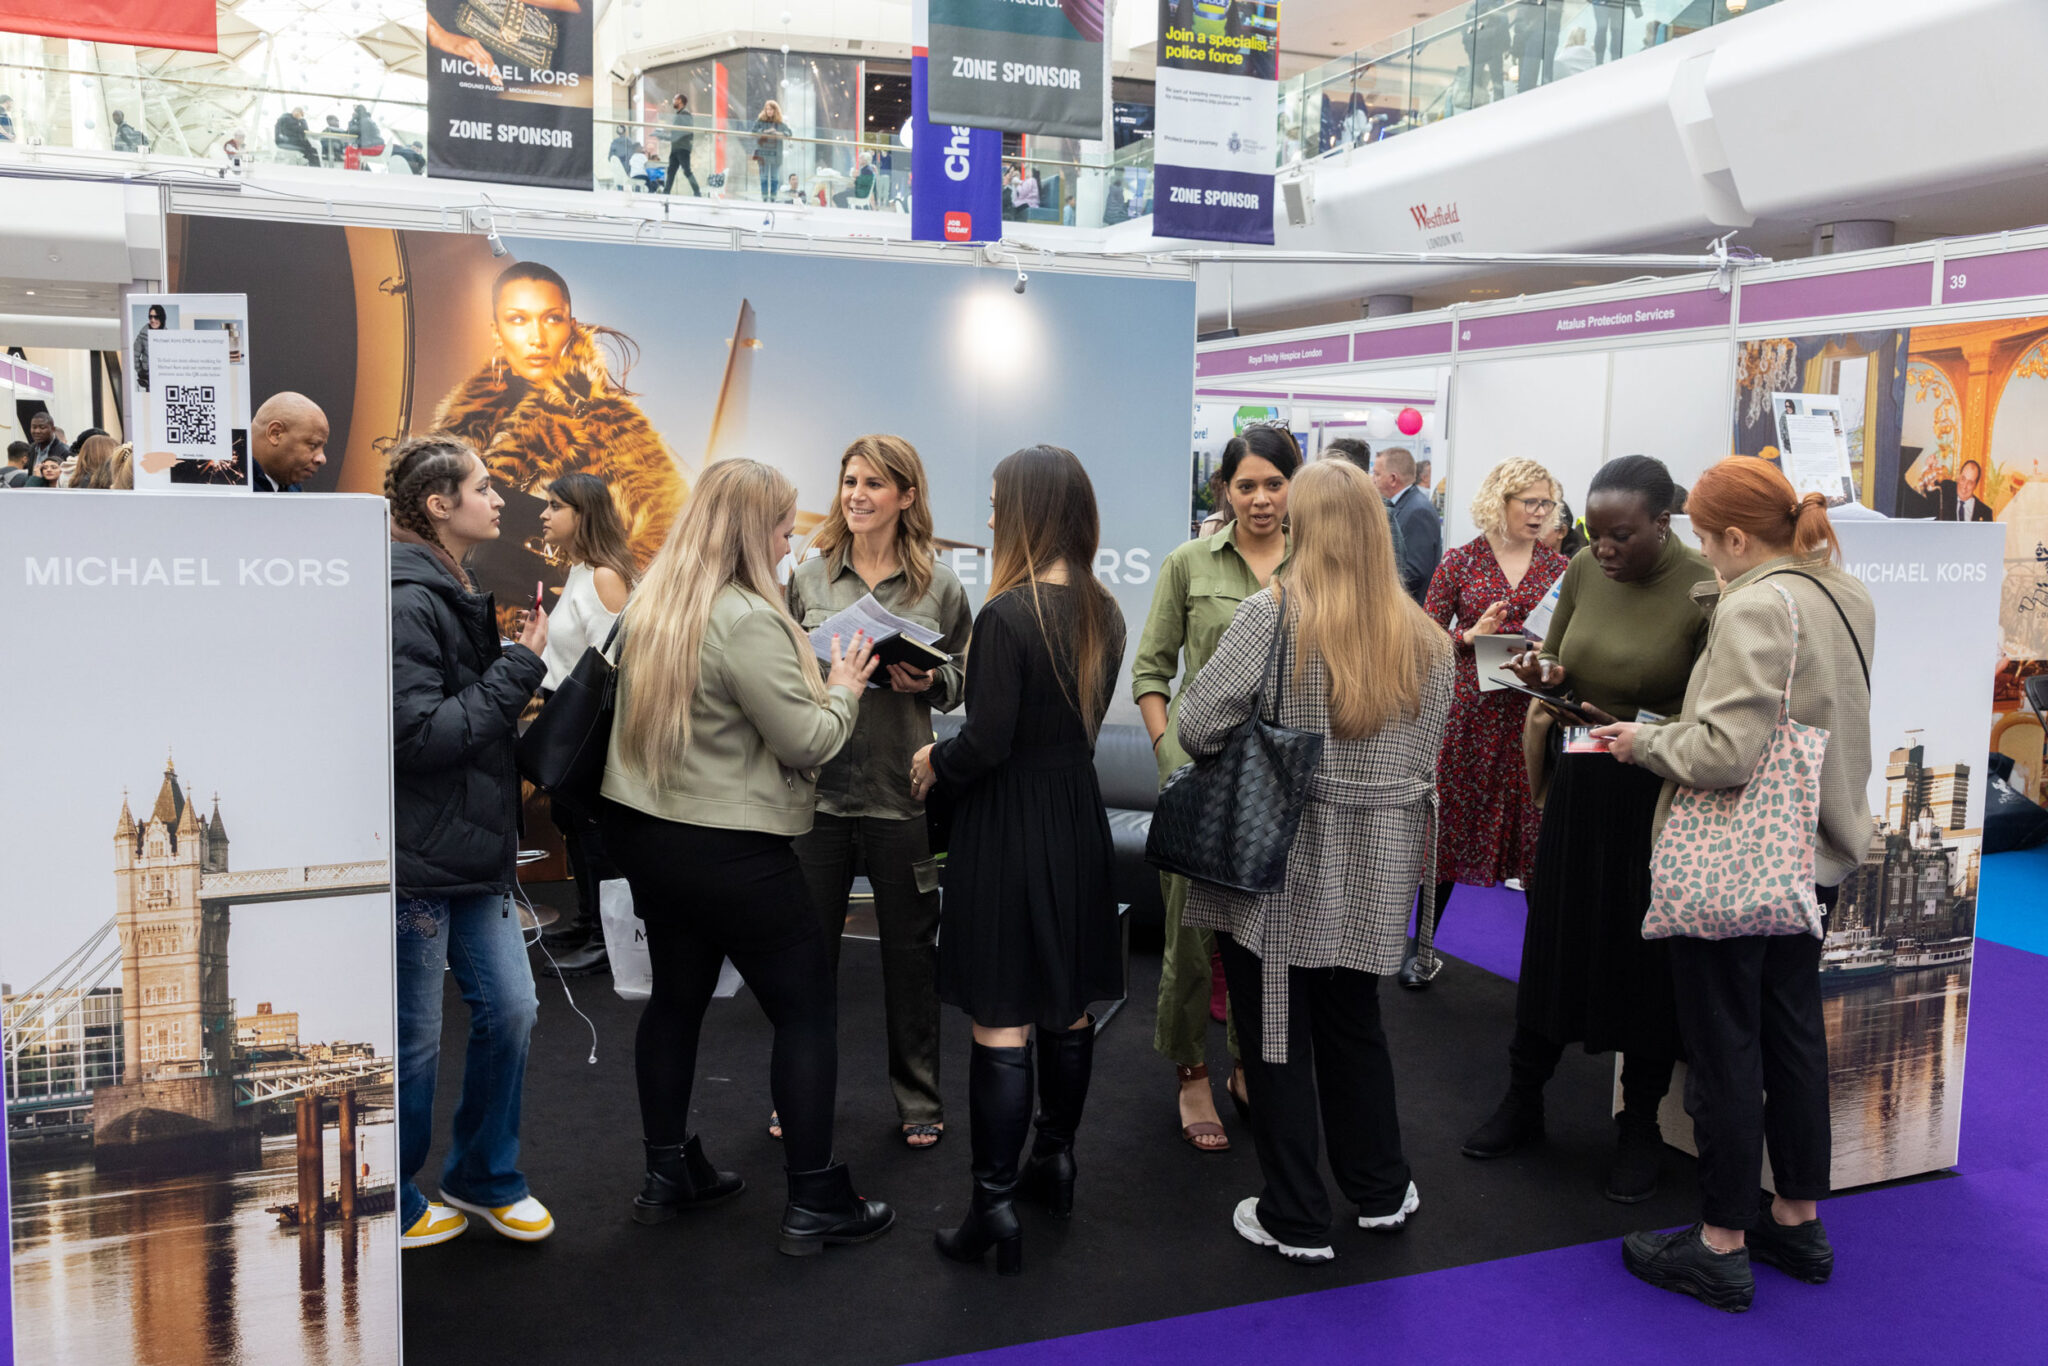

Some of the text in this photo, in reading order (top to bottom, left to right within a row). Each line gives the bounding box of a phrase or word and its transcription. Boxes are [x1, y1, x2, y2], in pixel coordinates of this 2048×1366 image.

[1166, 26, 1268, 52] Join a specialist
[1166, 45, 1243, 64] police force
[441, 58, 580, 87] MICHAEL KORS
[952, 56, 1080, 90] ZONE SPONSOR
[459, 82, 484, 90] GROUND
[486, 84, 504, 92] FLOOR
[450, 120, 573, 148] ZONE SPONSOR
[1170, 186, 1259, 210] ZONE SPONSOR
[1409, 202, 1461, 231] Westfield
[1950, 274, 1967, 289] 39
[1556, 308, 1675, 331] Attalus Protection Services
[1462, 330, 1471, 341] 40
[1248, 349, 1322, 366] Royal Trinity Hospice London
[1194, 428, 1208, 440] ore!
[24, 556, 350, 587] MICHAEL KORS
[1845, 562, 1987, 582] MICHAEL KORS
